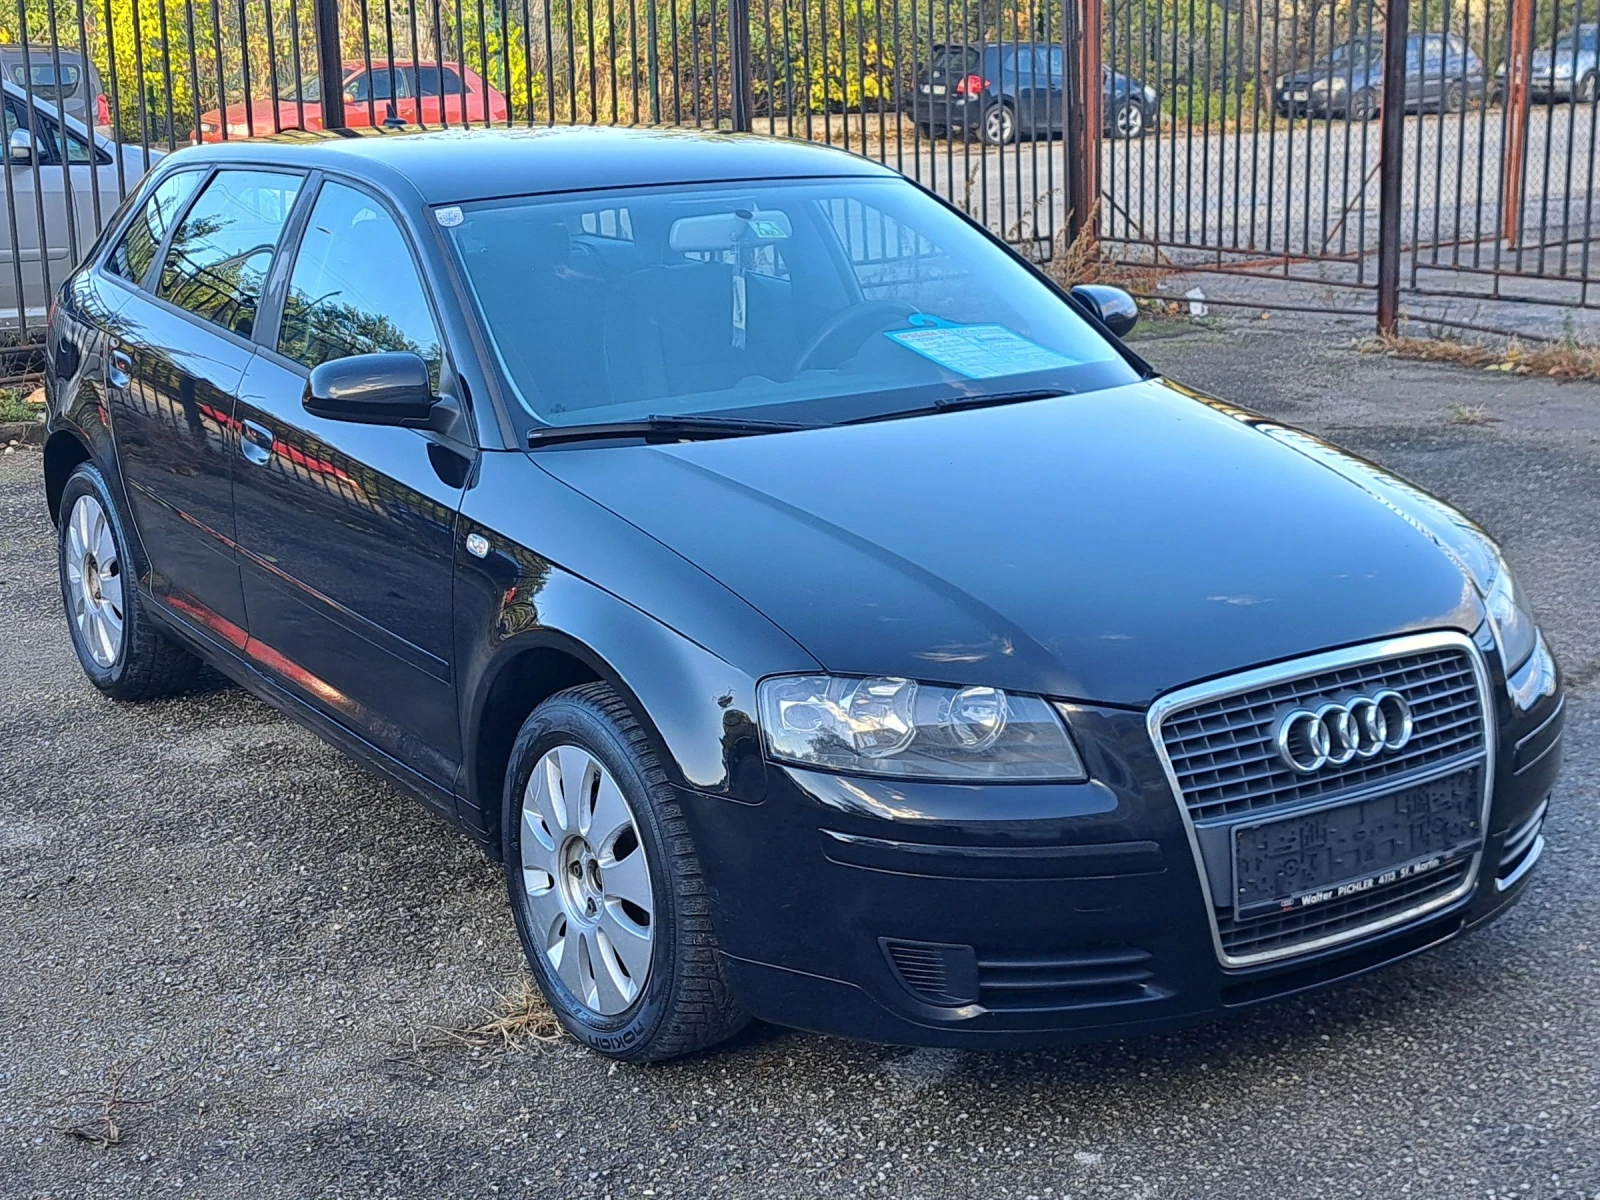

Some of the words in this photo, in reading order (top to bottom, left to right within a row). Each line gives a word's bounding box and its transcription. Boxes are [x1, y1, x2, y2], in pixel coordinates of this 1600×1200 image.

[1301, 891, 1333, 906] Walter
[1337, 878, 1375, 896] PICHLER
[1414, 858, 1441, 874] Martin
